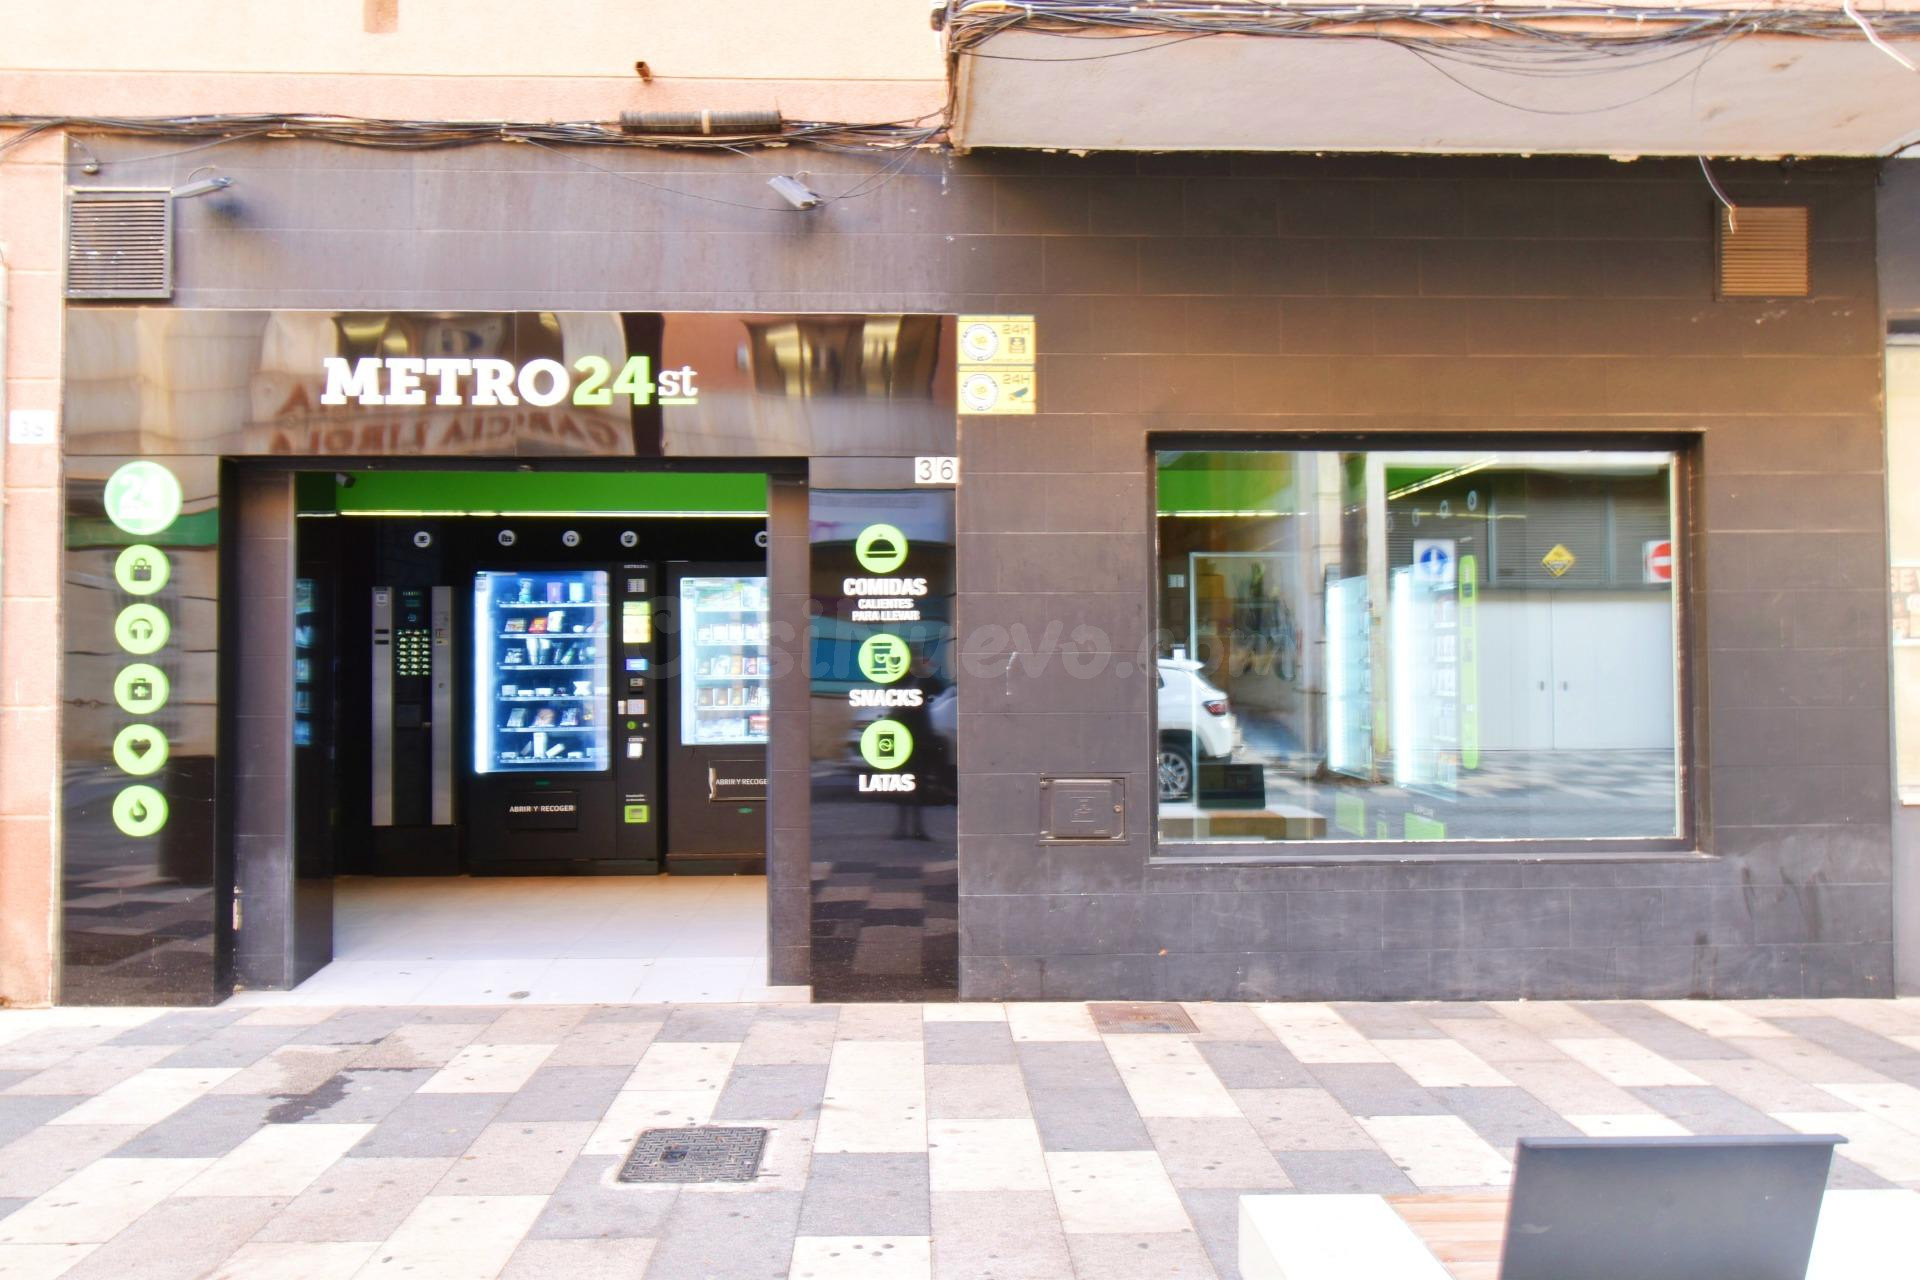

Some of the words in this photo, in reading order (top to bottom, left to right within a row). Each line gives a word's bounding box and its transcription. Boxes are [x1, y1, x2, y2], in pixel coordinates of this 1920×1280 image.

[919, 459, 953, 480] 36
[843, 578, 928, 596] COMIDAS
[857, 598, 914, 609] CALIENTES
[851, 610, 880, 621] PARA
[880, 610, 920, 621] LLEVAR
[848, 688, 924, 707] SNACKS
[715, 778, 735, 786] ABRIR
[858, 773, 916, 792] LATAS
[509, 805, 531, 813] ABRIR
[540, 804, 575, 812] RECOGER
